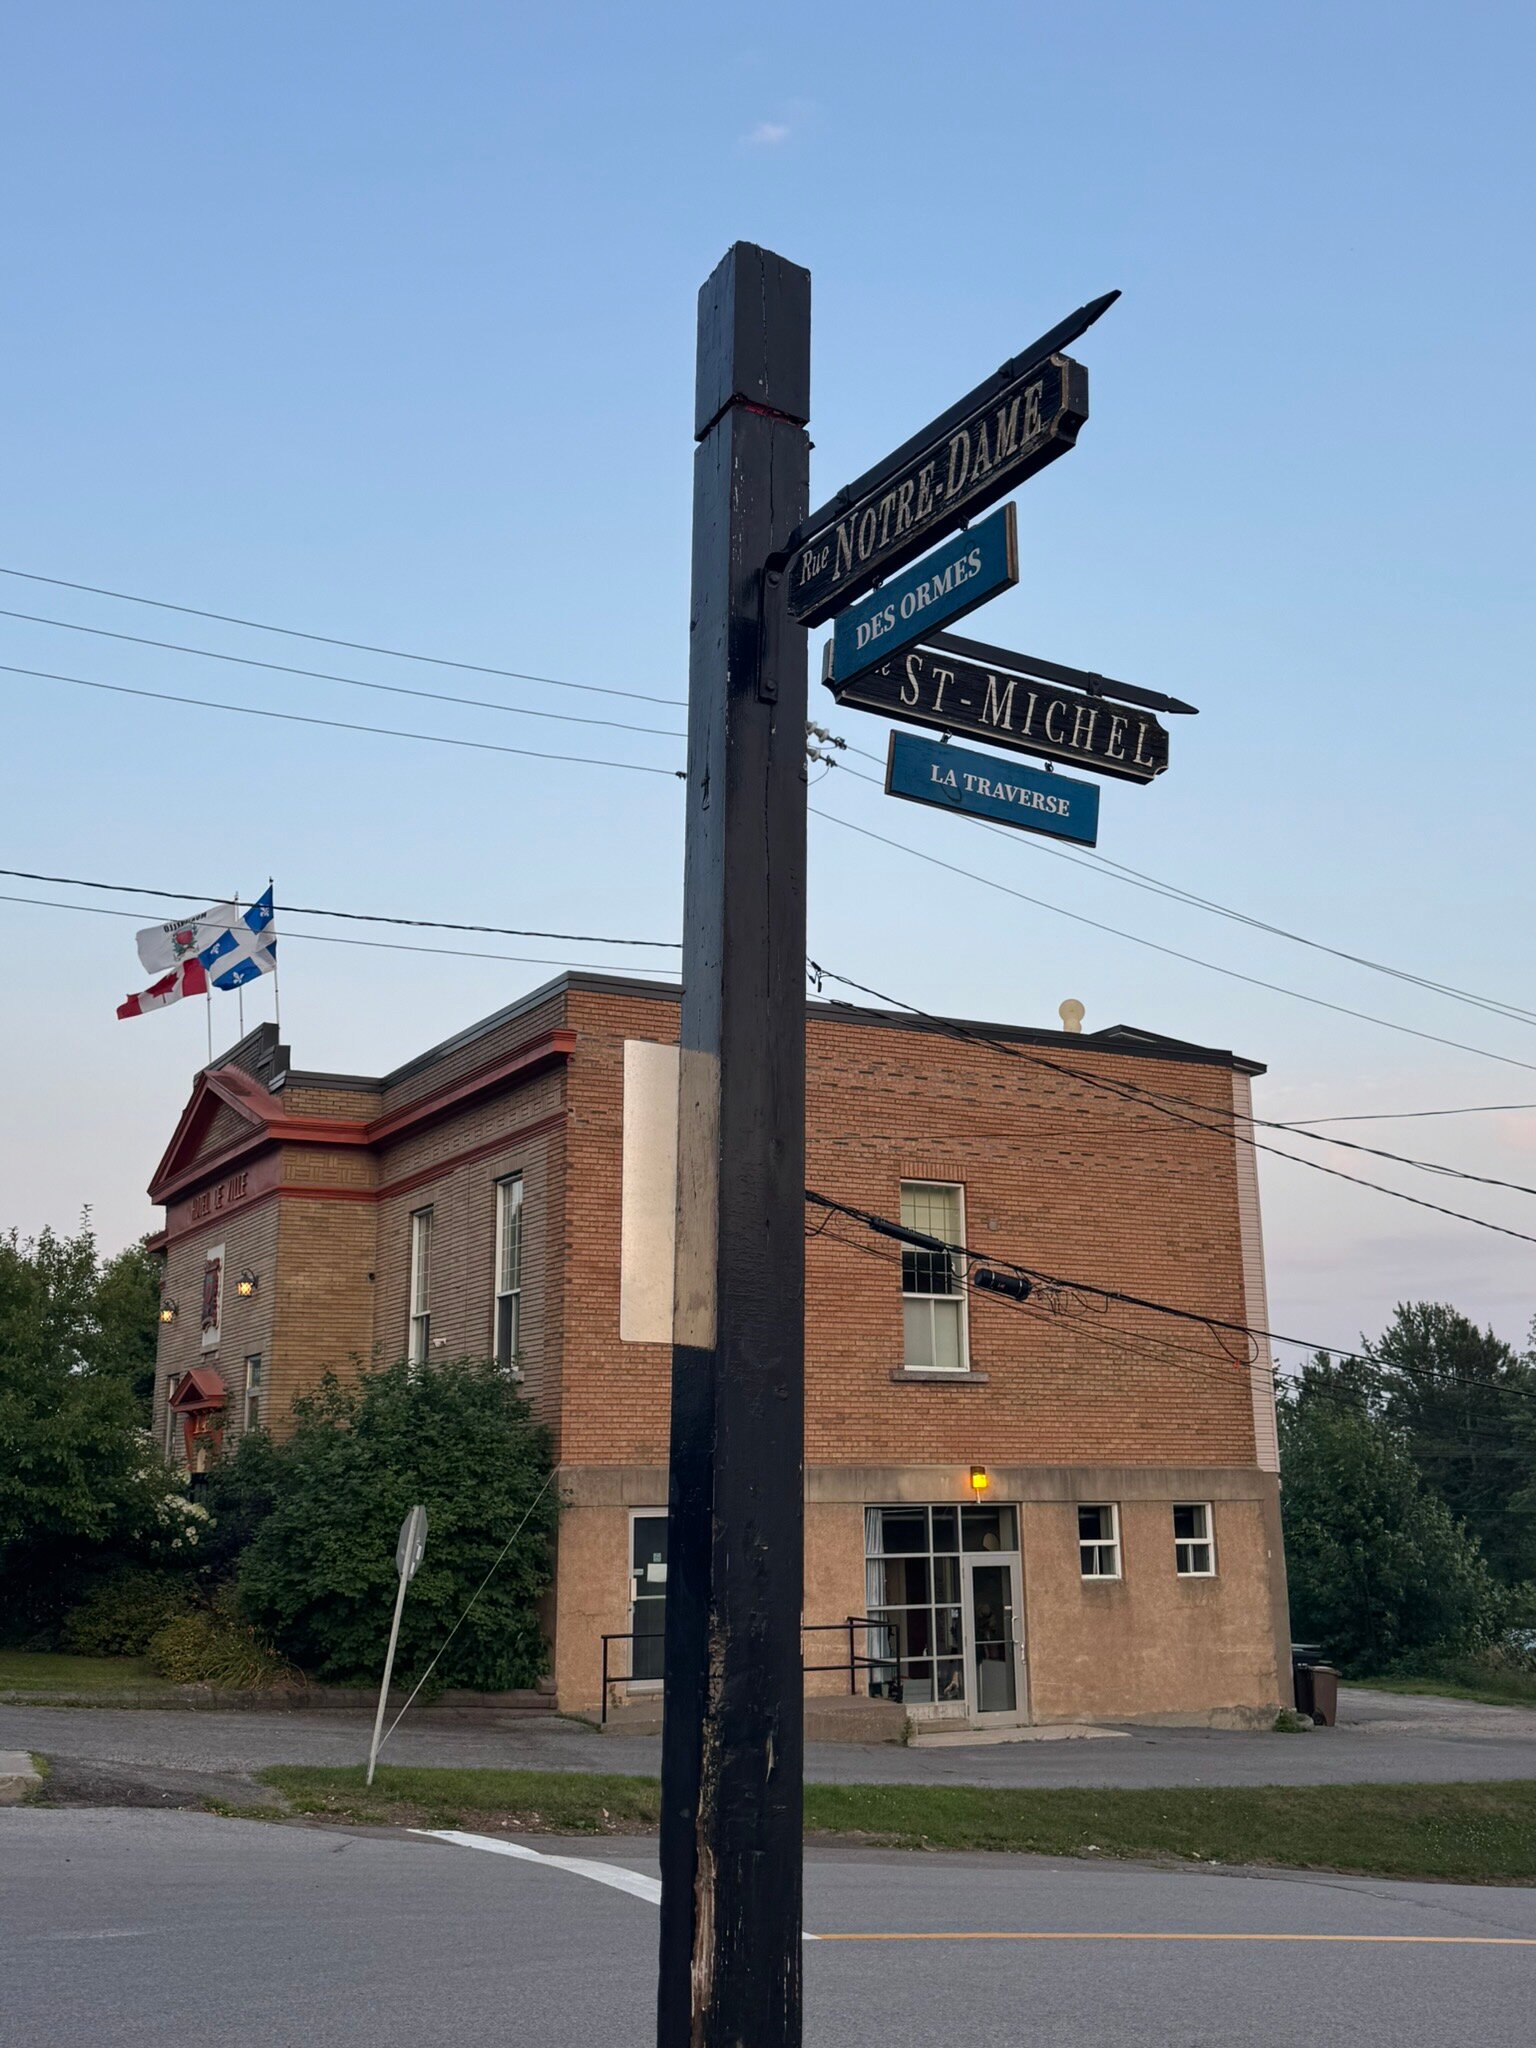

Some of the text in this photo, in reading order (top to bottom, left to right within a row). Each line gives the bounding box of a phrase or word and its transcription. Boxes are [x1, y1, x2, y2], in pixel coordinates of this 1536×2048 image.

[800, 380, 1043, 585] Rue NOTRE-DAME
[856, 547, 982, 650] DES ORMES
[900, 654, 1153, 767] ST-MICHEL
[930, 765, 1070, 817] LA TRAVERSE
